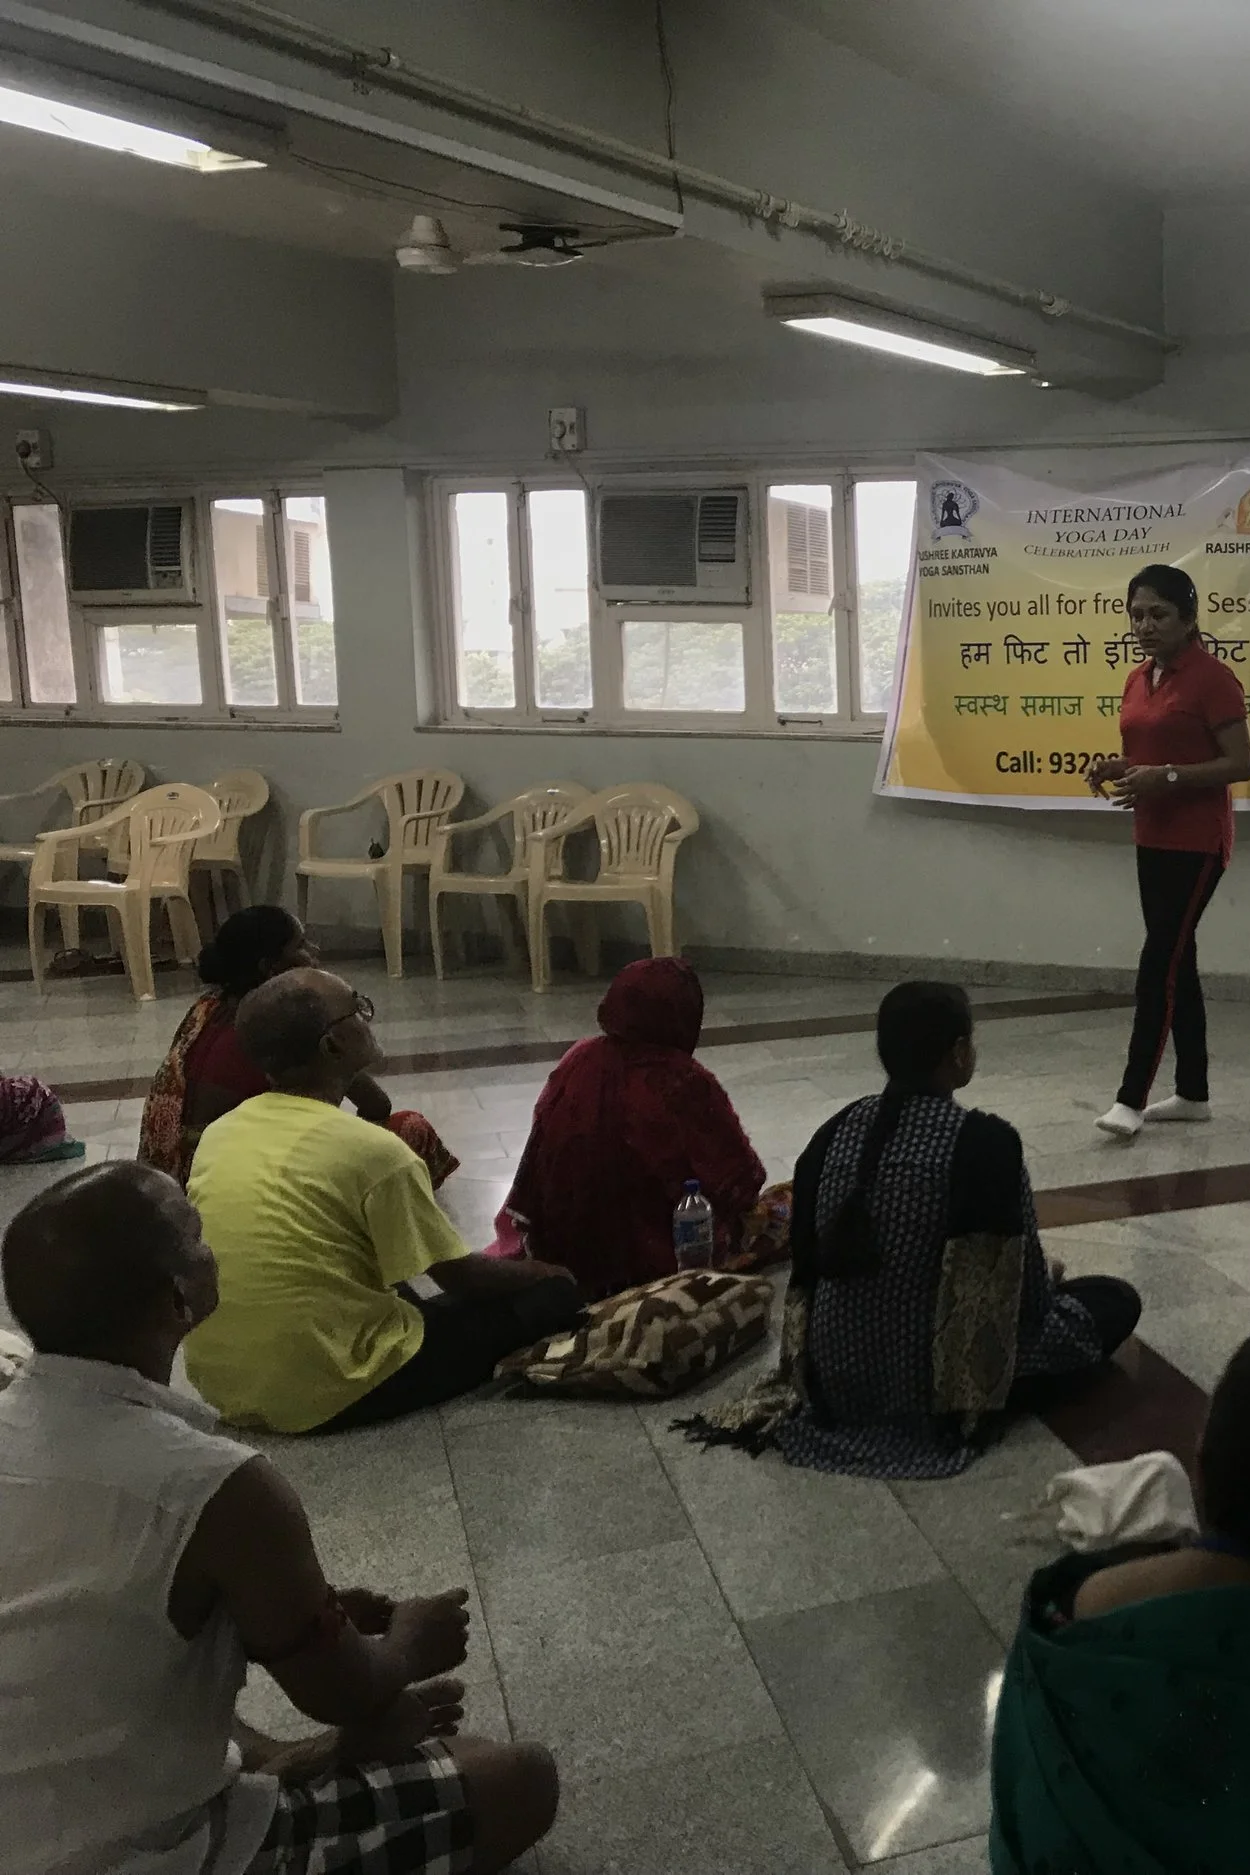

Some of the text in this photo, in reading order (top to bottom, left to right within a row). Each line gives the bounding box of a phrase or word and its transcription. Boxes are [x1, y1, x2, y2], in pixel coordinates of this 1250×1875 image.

[1026, 503, 1187, 524] INTERNATIONAL
[1055, 526, 1153, 544] YOGA DAY
[951, 547, 998, 559] KARTAVYA
[1024, 542, 1171, 558] CELEBRATING HEALTH
[941, 563, 990, 576] SANSTHAN
[928, 597, 981, 618] Invites
[987, 600, 1021, 621] you
[1028, 594, 1050, 616] all
[1056, 593, 1087, 615] for
[1093, 593, 1127, 615] fre
[960, 642, 993, 669] हम
[1002, 633, 1050, 664] फिट
[1062, 633, 1091, 665] तो
[954, 694, 1009, 717] स्वस्थ
[1020, 695, 1084, 717] समाज
[996, 750, 1042, 774] Call:
